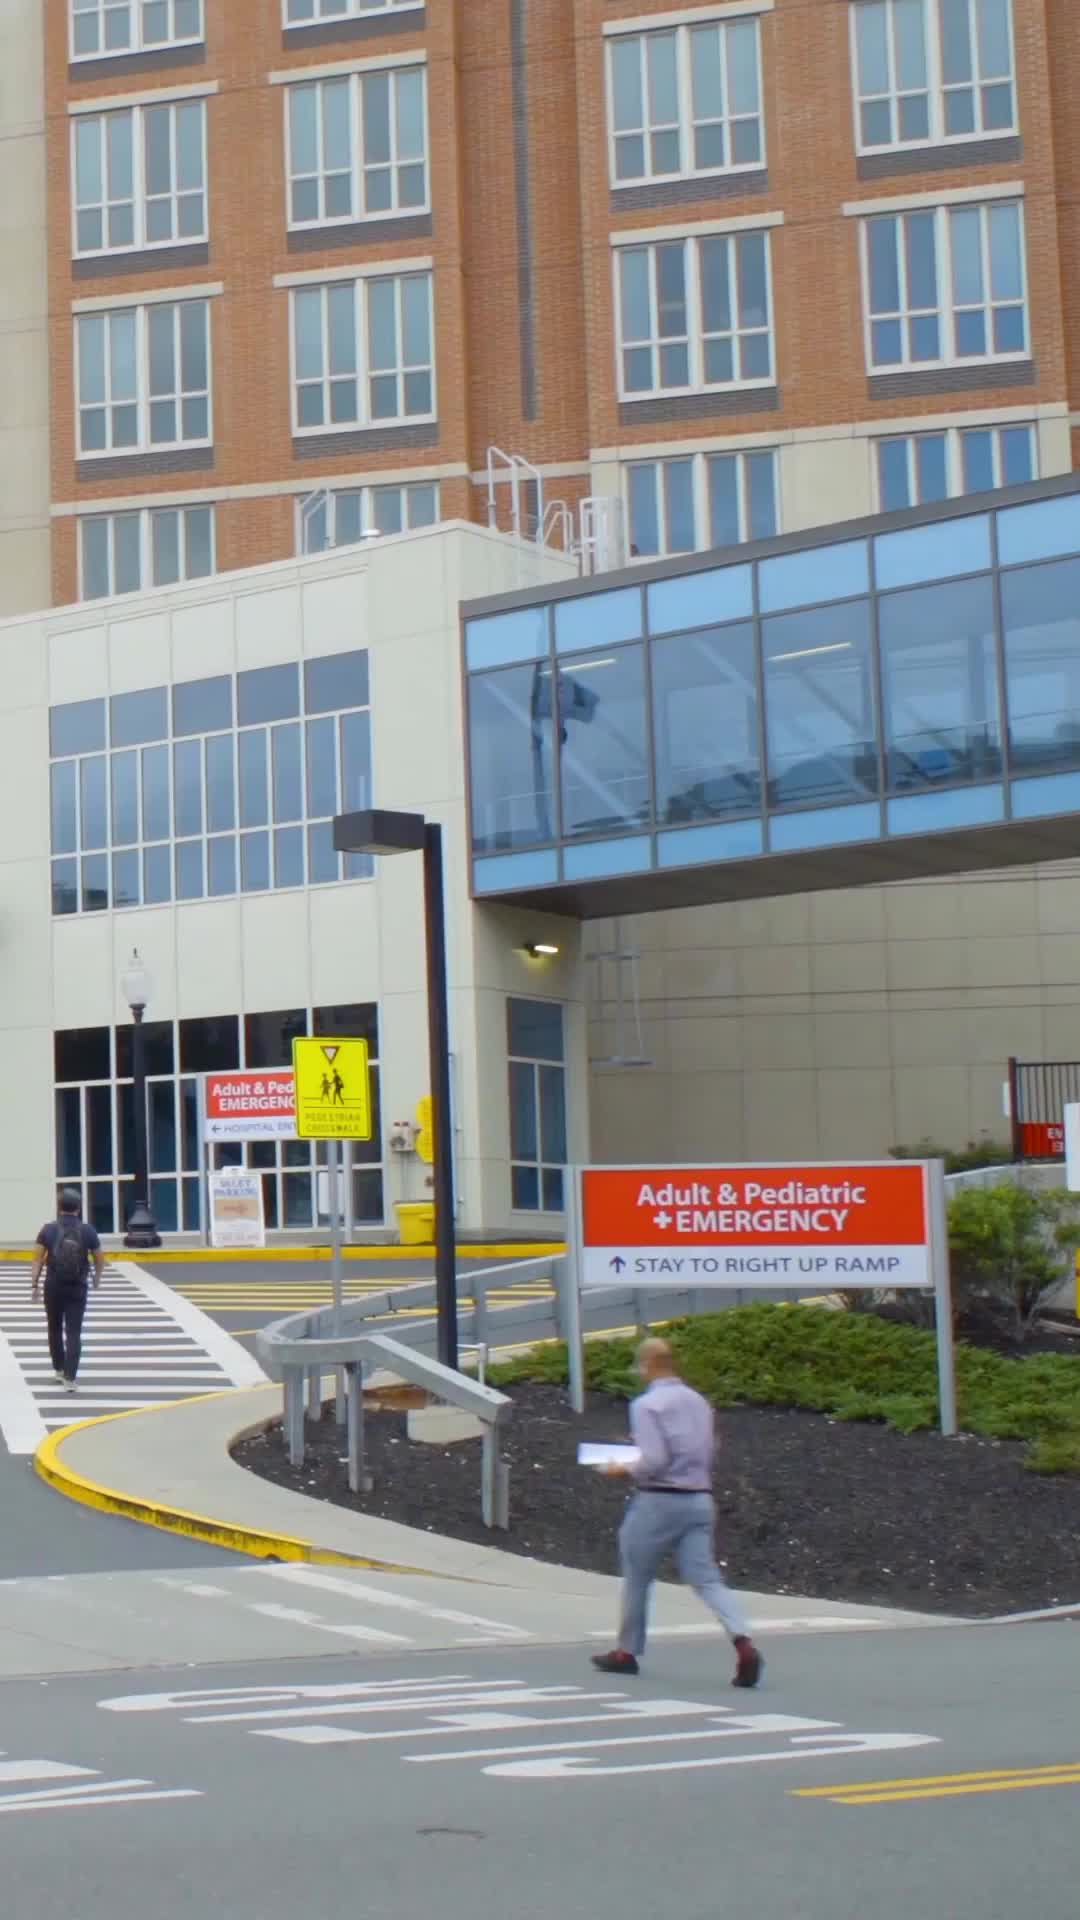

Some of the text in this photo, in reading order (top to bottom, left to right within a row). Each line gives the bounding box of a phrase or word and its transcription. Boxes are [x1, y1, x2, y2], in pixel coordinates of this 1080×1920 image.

[212, 1080, 295, 1096] Adult & Ped
[219, 1095, 296, 1112] EMERGENC
[637, 1181, 867, 1206] Adult & Pediatric
[676, 1208, 849, 1232] EMERGENCY
[634, 1256, 901, 1273] STAY TO RIGHT UP RAMP
